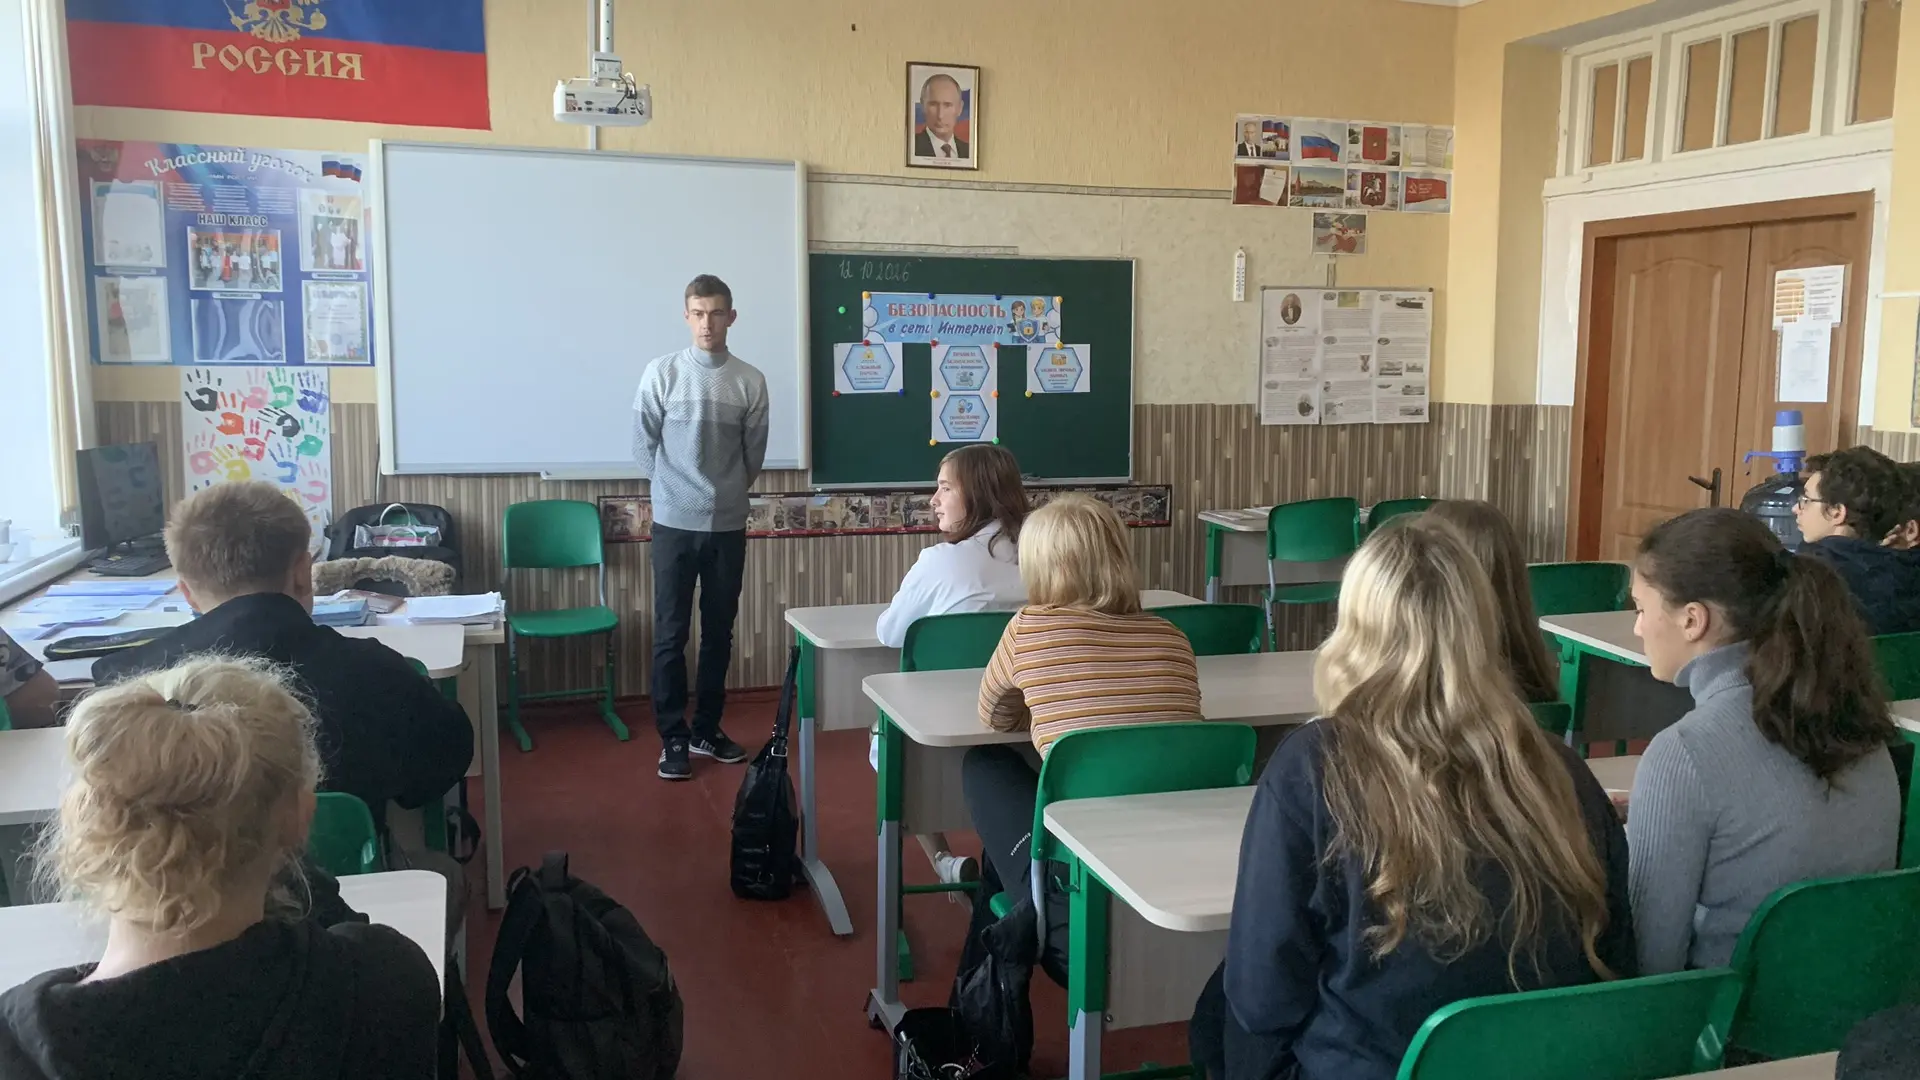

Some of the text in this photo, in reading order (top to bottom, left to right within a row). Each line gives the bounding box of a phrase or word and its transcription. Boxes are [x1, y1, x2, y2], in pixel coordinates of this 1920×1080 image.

[192, 42, 365, 81] РОССИЯ
[144, 147, 248, 177] Классный
[197, 213, 268, 227] НАШ КЛАСС
[888, 303, 1006, 319] БЕЗОПАСНОСТЬ
[888, 321, 1004, 337] в сети Интернет
